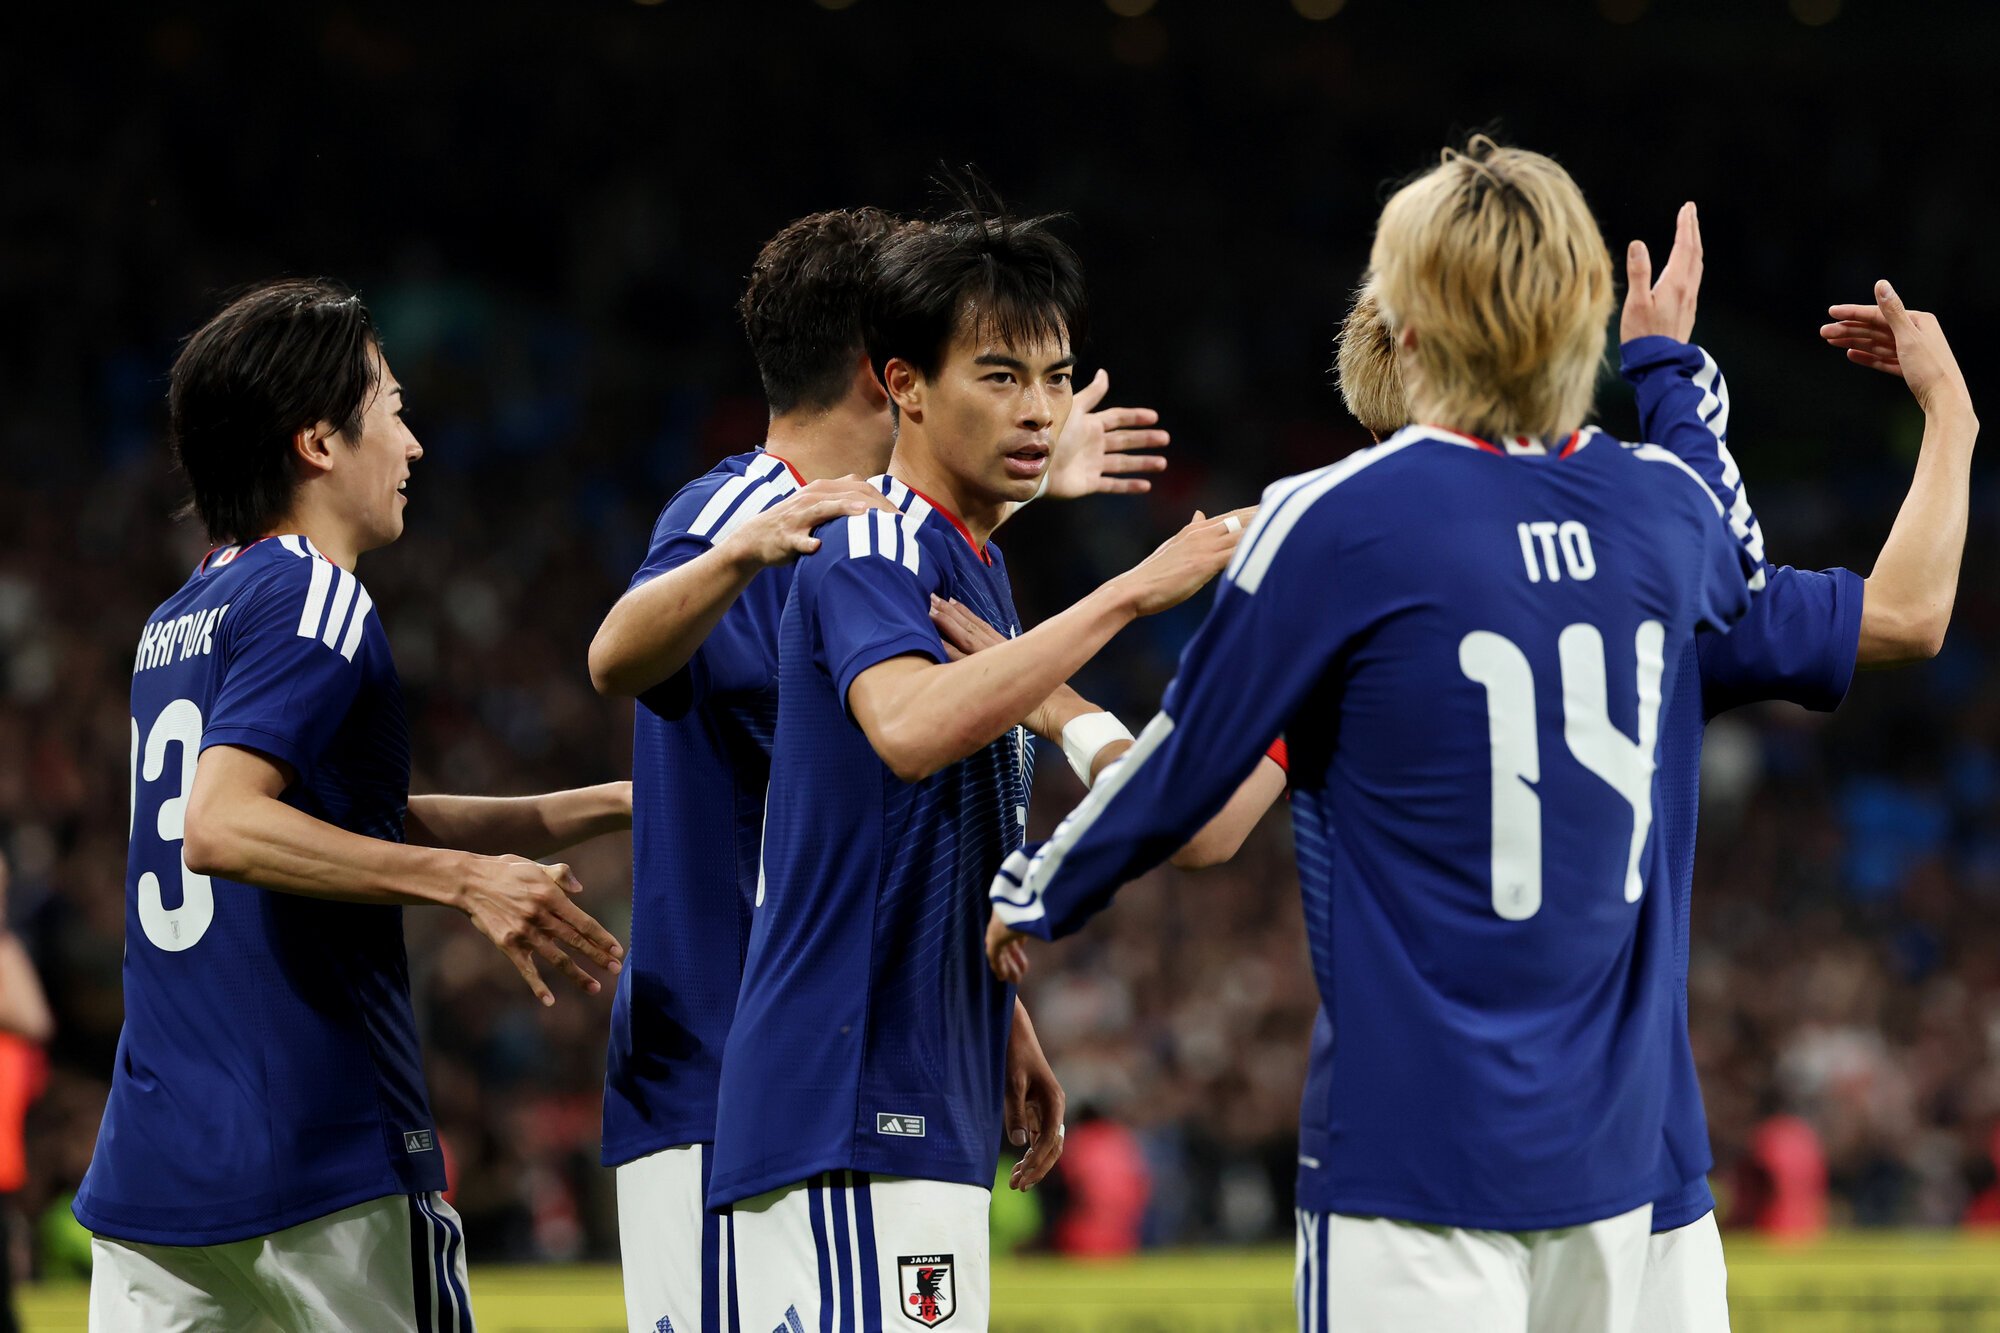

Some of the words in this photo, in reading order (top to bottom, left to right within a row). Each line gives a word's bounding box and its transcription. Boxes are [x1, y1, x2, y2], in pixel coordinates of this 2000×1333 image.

[1517, 520, 1597, 583] ITO
[1458, 619, 1665, 920] 14
[129, 698, 214, 952] 3
[910, 1256, 941, 1264] JAPAN
[916, 1305, 942, 1317] JFA
